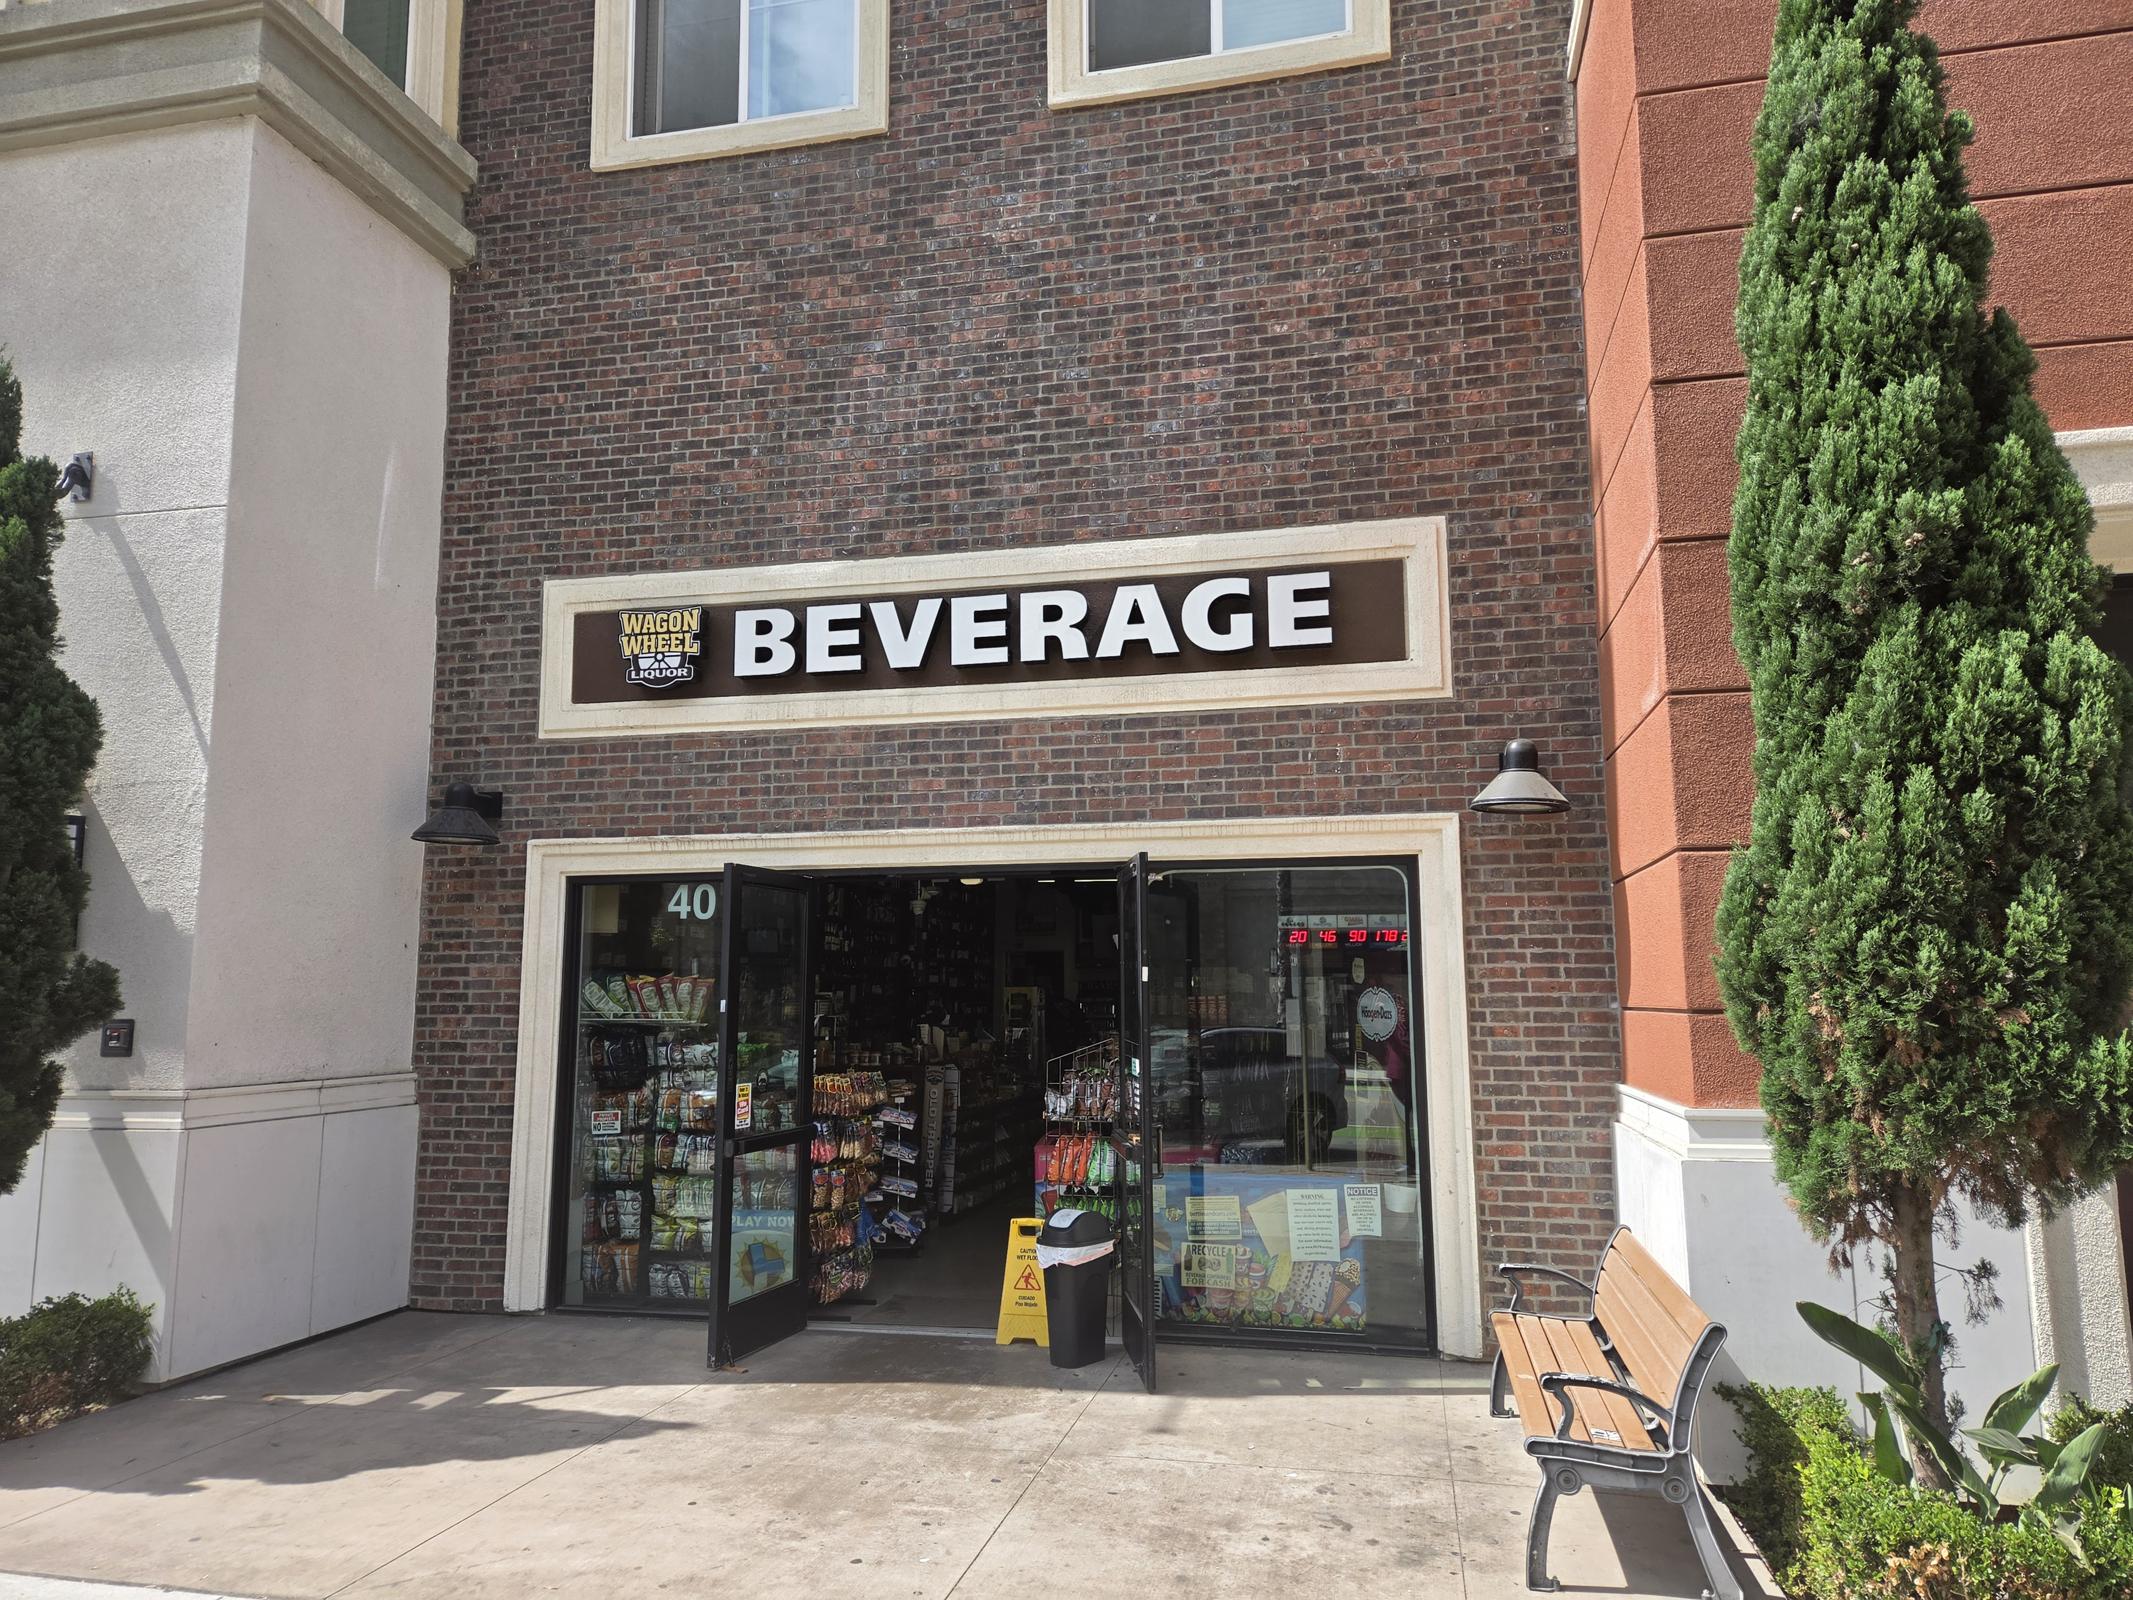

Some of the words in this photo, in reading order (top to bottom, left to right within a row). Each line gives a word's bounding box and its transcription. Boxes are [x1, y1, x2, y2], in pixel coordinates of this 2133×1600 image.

[621, 609, 699, 634] WAGON
[734, 571, 1332, 677] BEVERAGE
[621, 632, 698, 656] WHEEL
[631, 668, 688, 679] LIQUOR
[667, 884, 716, 920] 40
[1289, 931, 1307, 942] 20
[1320, 930, 1336, 942] 46
[1349, 930, 1367, 942] 90
[1376, 930, 1398, 942] 178
[1347, 1188, 1377, 1196] NOTICE
[1191, 1244, 1226, 1257] RECYCLE
[1207, 1279, 1231, 1287] CASH
